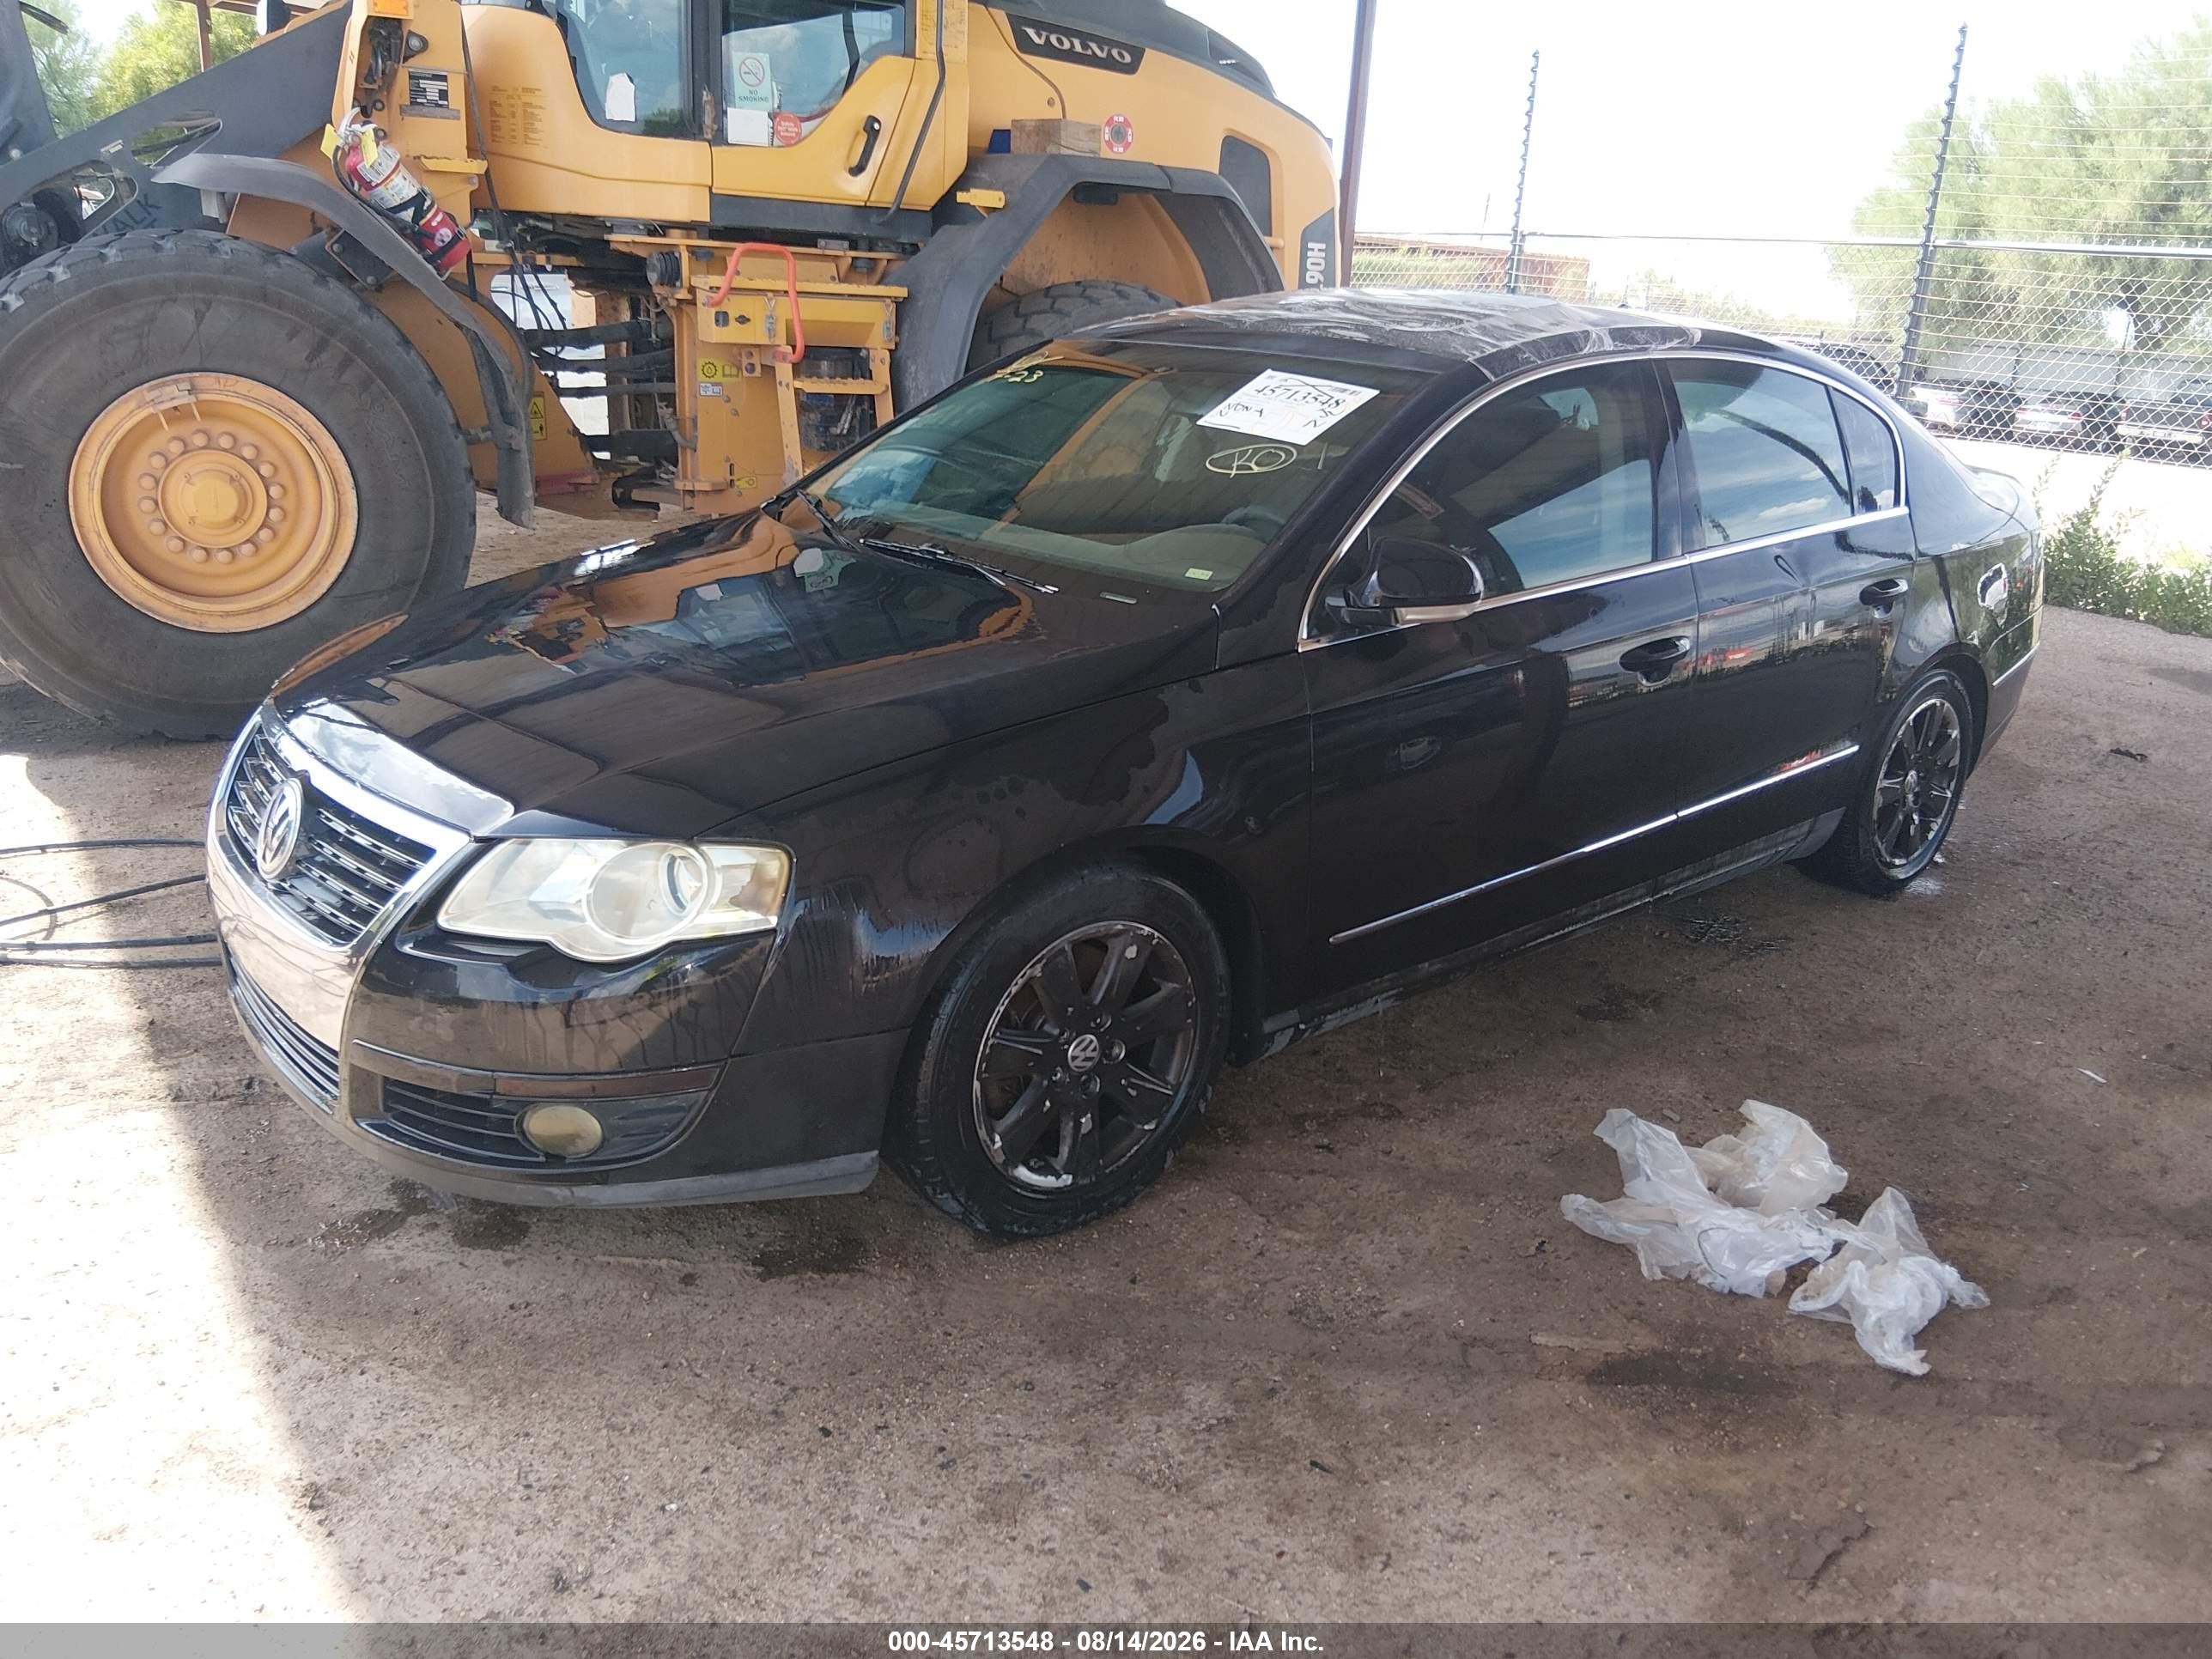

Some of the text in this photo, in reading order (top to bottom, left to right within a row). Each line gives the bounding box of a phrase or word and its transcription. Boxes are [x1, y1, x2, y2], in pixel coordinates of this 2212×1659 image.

[1022, 27, 1132, 64] VOLVO
[1305, 242, 1326, 290] 90H
[1255, 386, 1346, 409] 45713548
